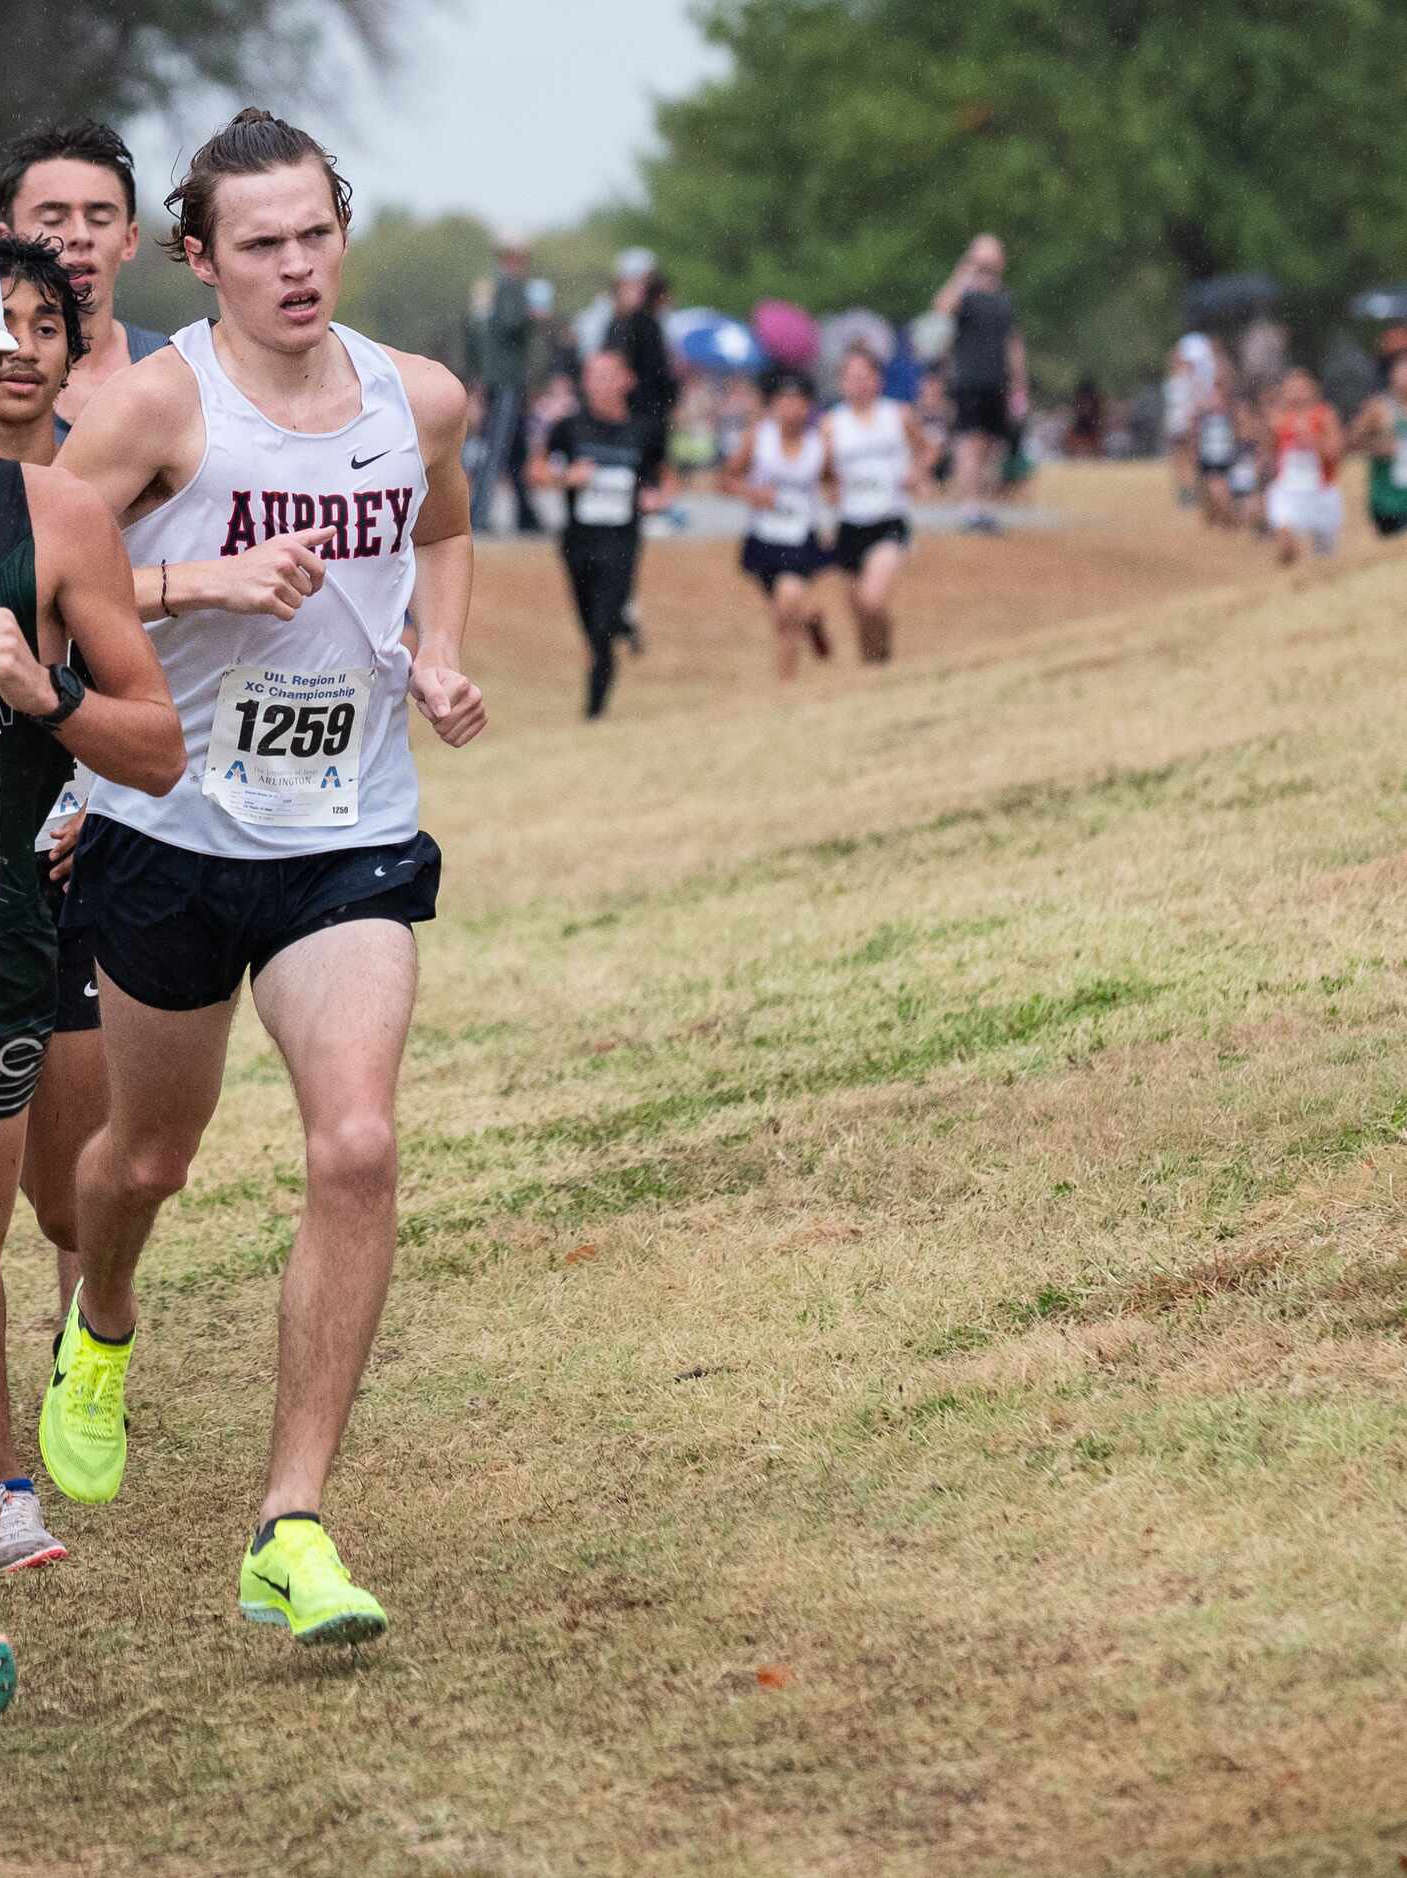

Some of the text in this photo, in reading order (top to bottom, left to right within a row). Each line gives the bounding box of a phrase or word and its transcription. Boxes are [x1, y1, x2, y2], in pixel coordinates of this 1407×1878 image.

[264, 671, 287, 684] UIL
[292, 674, 335, 687] Region
[244, 681, 355, 701] XC Championship
[235, 699, 356, 758] 1259
[258, 775, 312, 787] ARLINGTON
